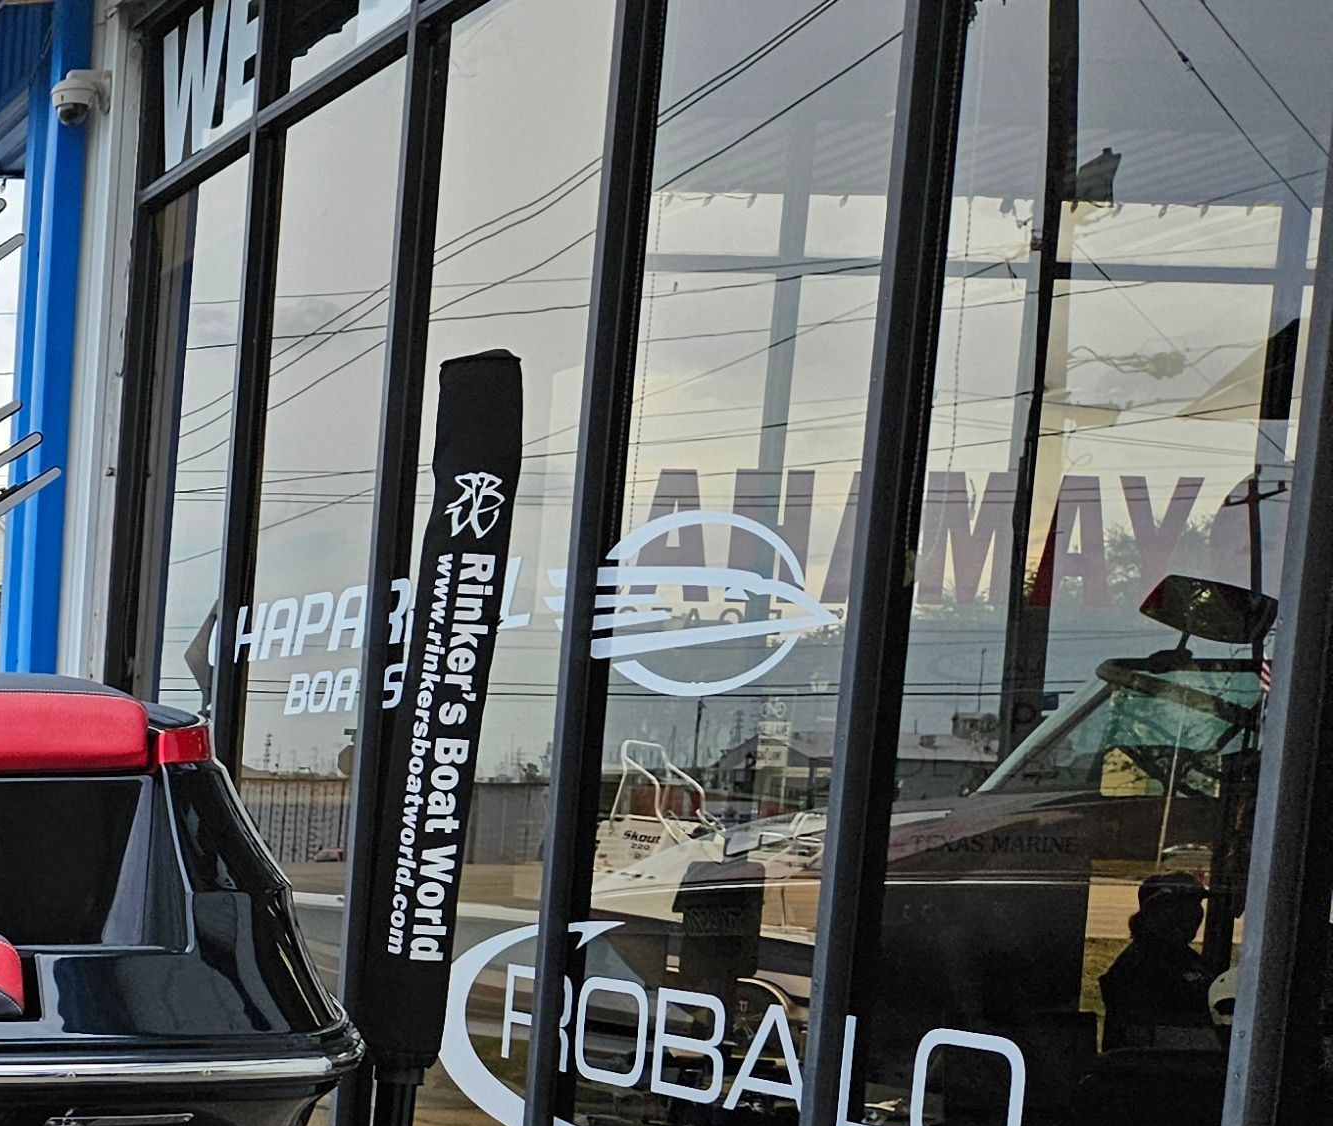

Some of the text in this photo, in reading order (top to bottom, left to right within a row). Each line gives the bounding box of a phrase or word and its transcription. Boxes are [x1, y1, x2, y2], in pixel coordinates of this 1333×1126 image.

[284, 662, 409, 716] BOAS
[387, 553, 454, 955] www.rinkersboatworld.com
[409, 553, 496, 961] Rinker's Boat World
